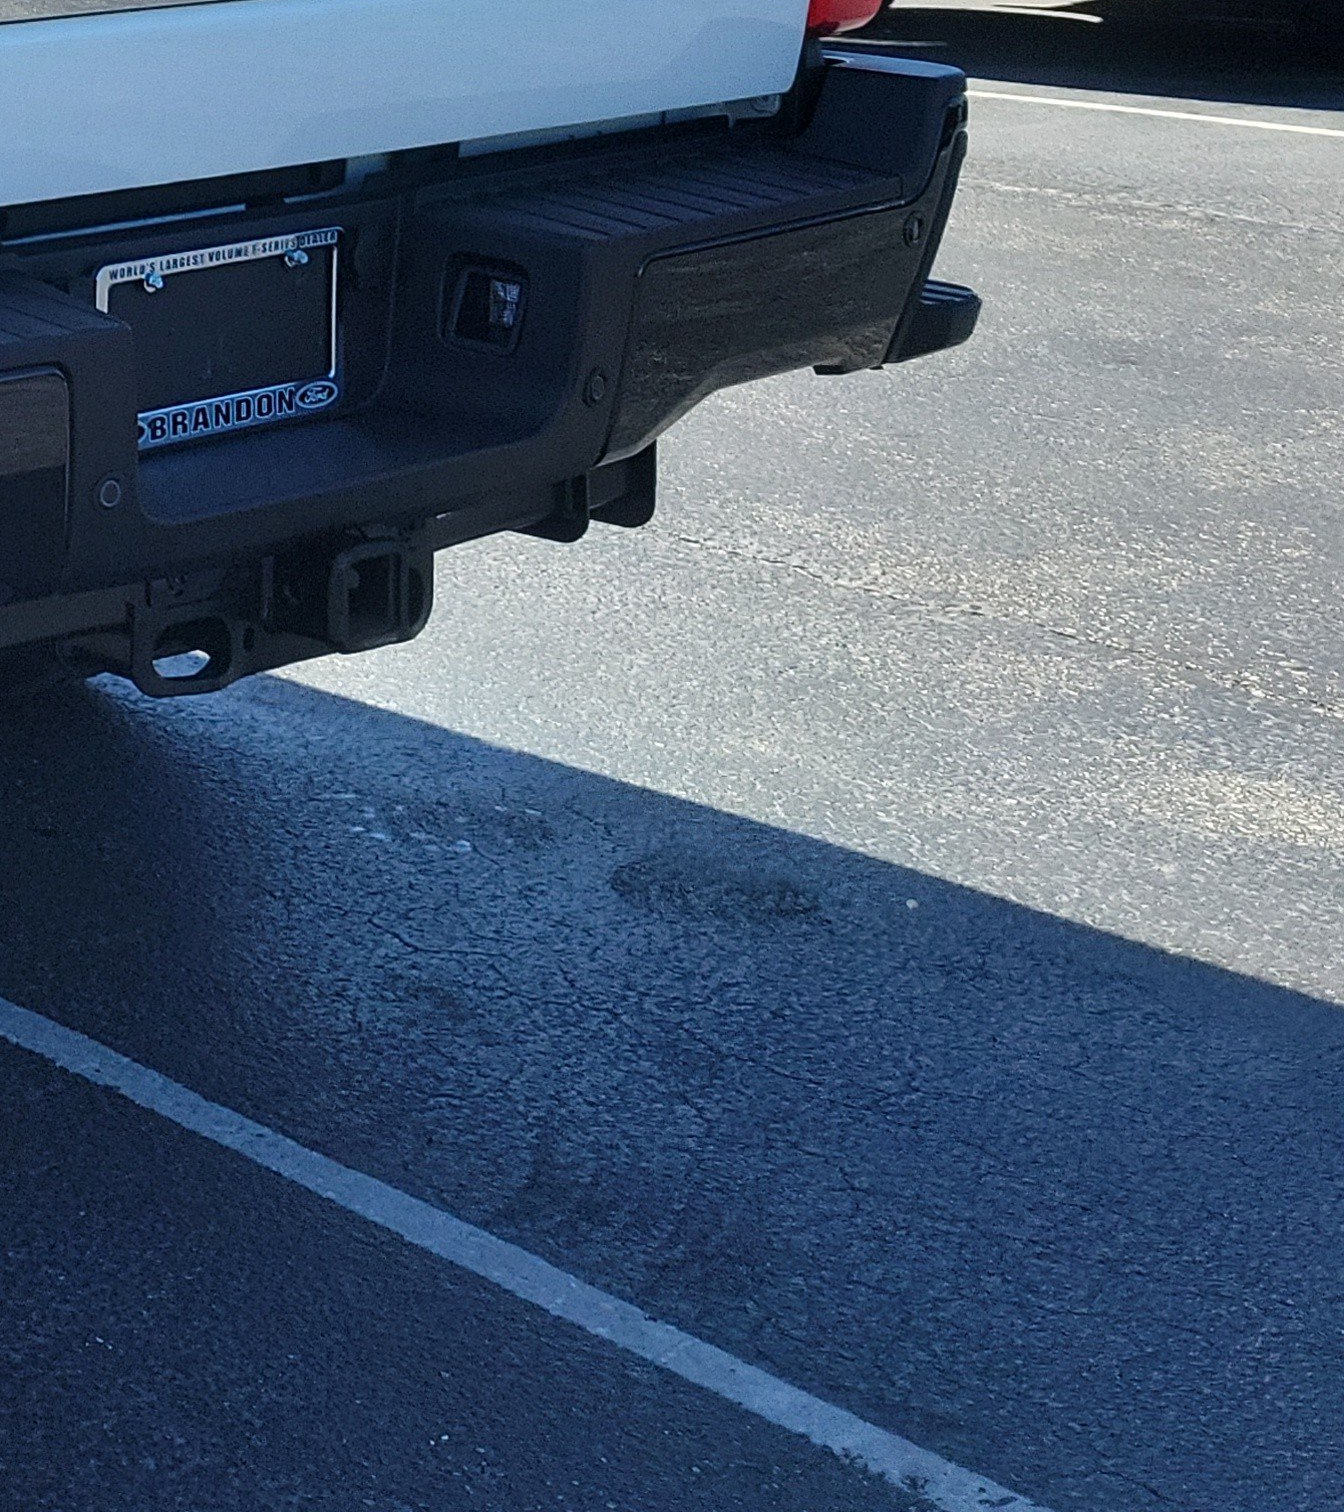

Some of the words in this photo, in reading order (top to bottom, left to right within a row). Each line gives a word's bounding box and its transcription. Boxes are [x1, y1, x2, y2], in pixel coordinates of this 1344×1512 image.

[108, 262, 157, 281] WORLD'S
[159, 253, 205, 272] LARGEST
[207, 248, 249, 264] VOLUME
[148, 386, 297, 441] BRANDON
